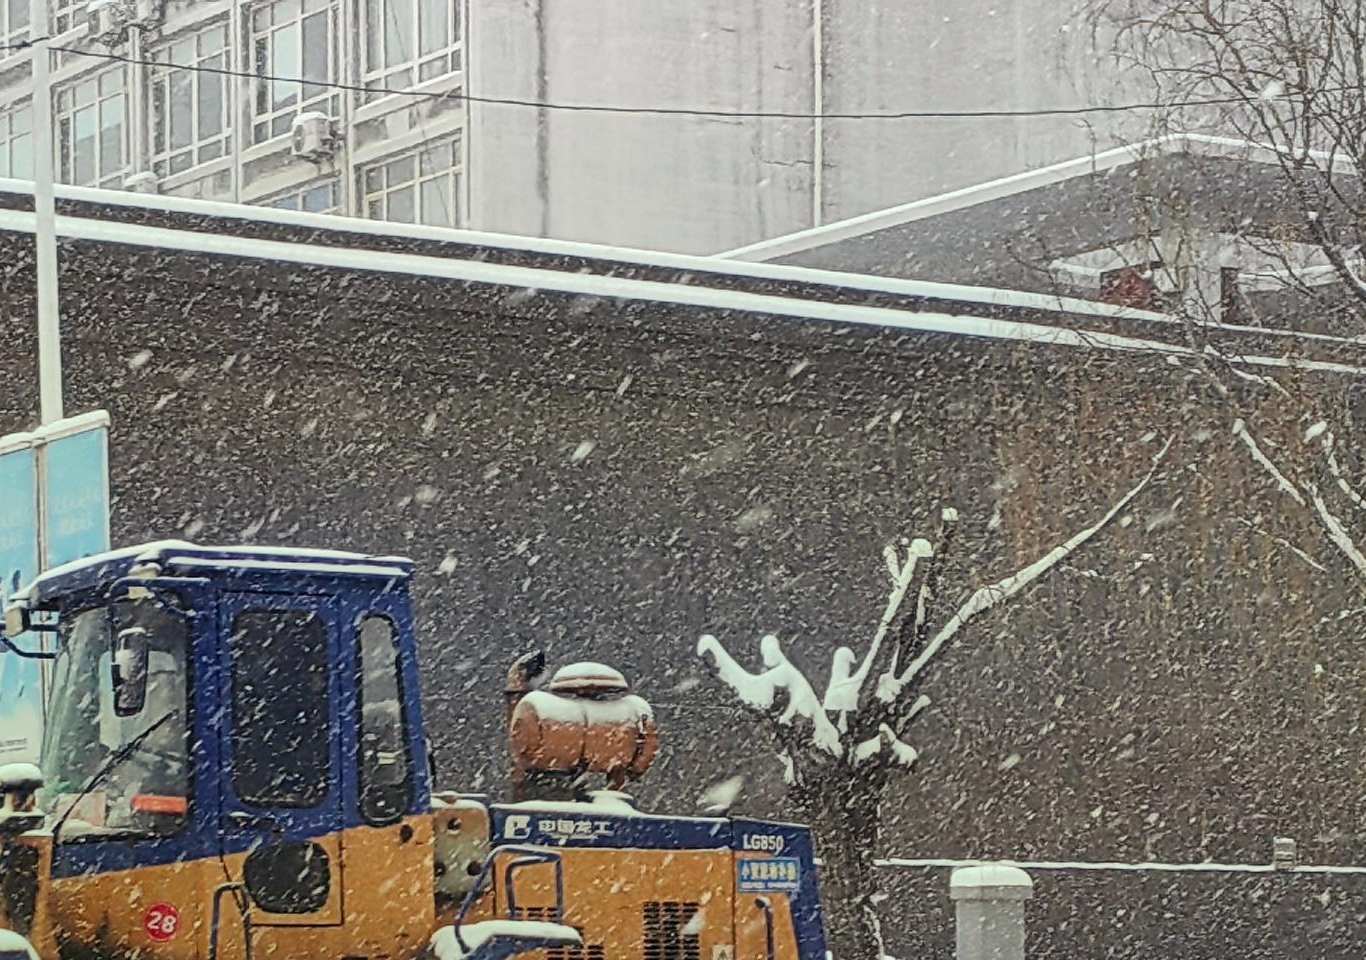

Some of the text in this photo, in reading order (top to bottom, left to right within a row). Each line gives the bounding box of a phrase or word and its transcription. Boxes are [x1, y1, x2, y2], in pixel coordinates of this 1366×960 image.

[538, 819, 615, 837] 中国龙工
[742, 833, 785, 852] LG850
[146, 910, 177, 933] 28
